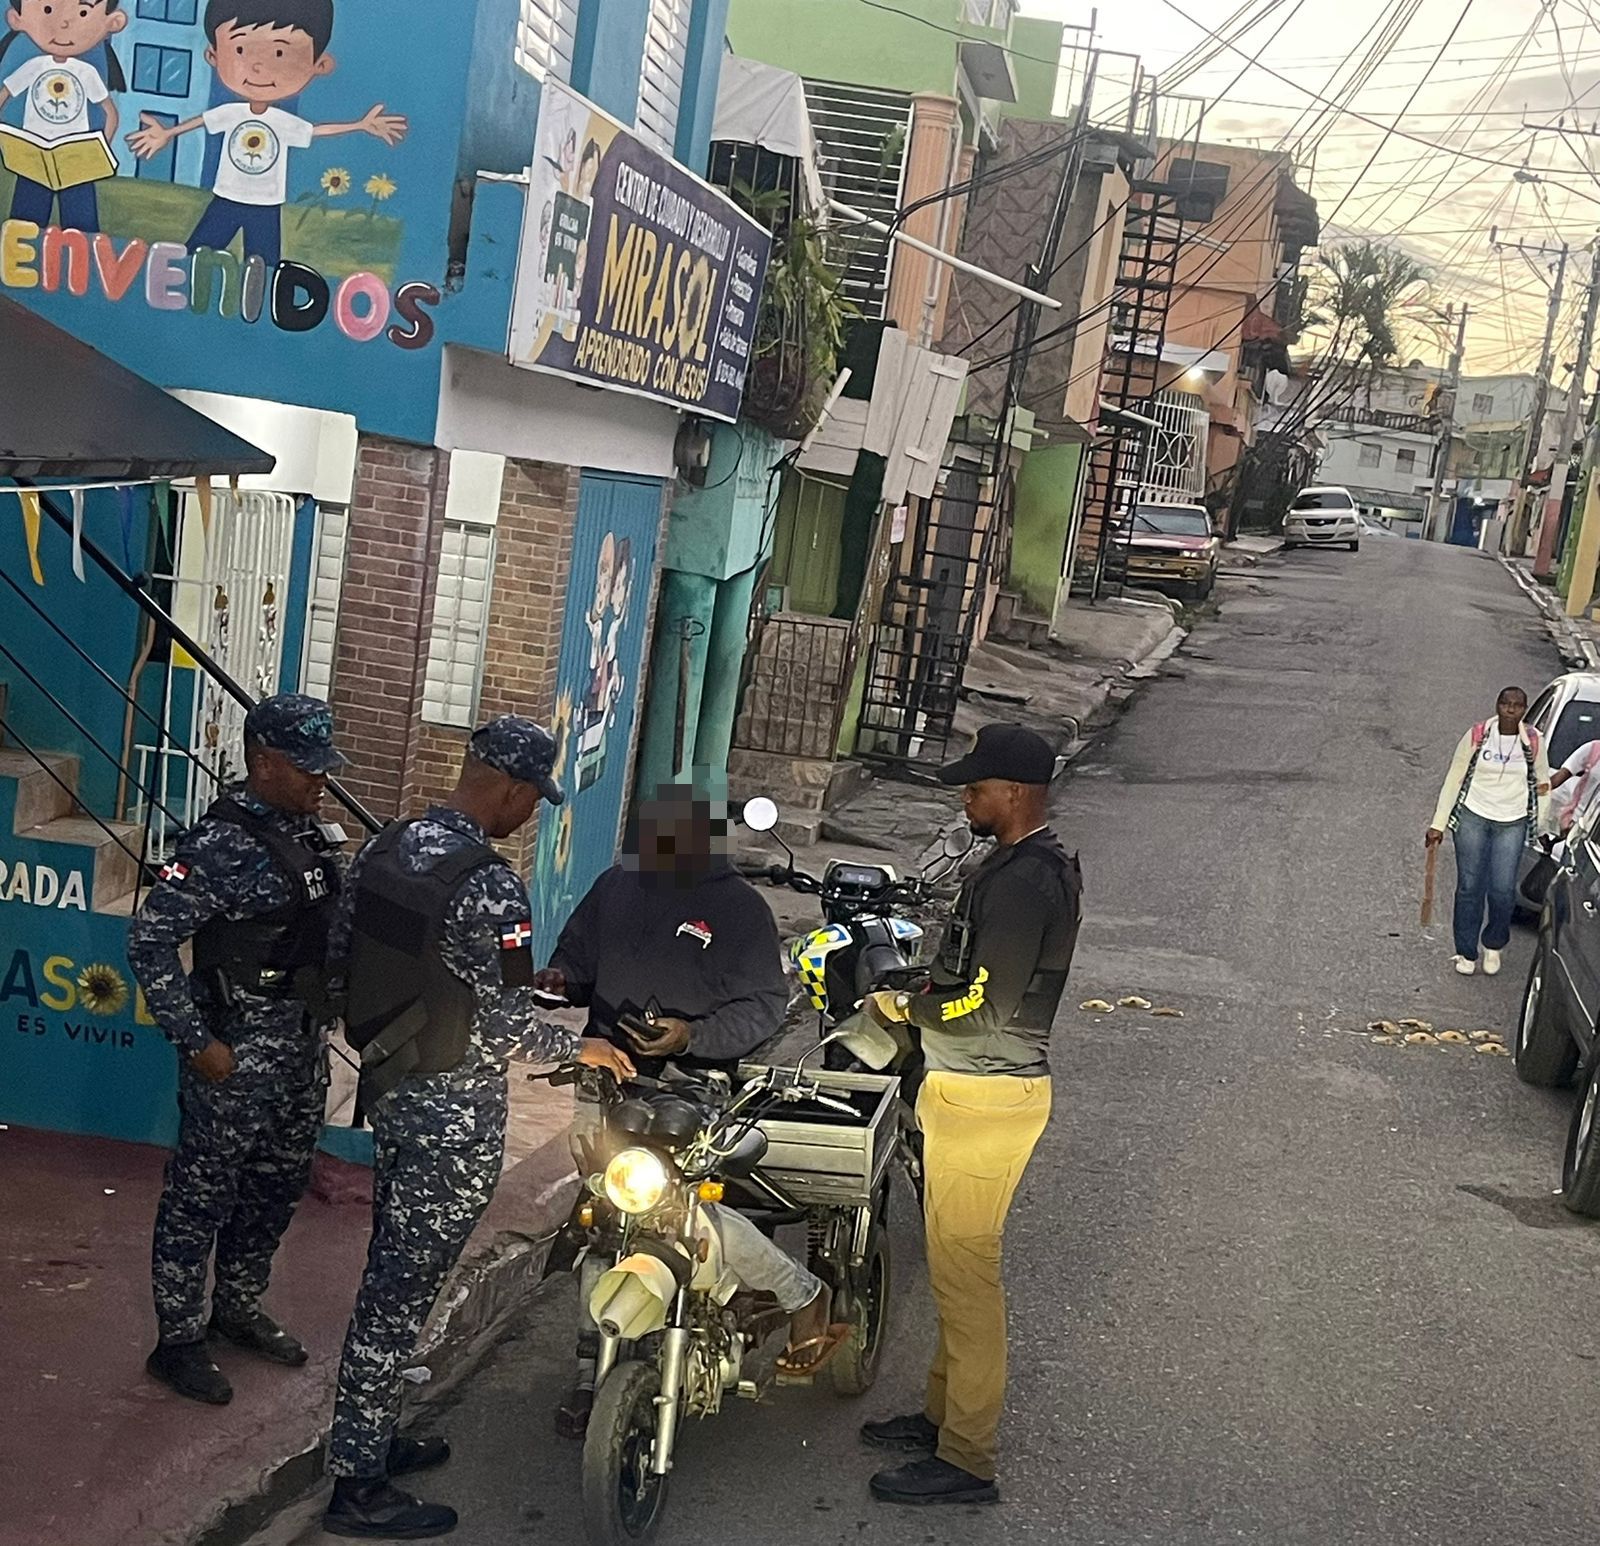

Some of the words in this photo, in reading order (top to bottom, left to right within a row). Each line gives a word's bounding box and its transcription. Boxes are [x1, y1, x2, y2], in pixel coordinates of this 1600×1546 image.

[614, 161, 650, 216] CENTRO
[645, 181, 662, 222] DE
[595, 212, 718, 362] MIRASOL
[573, 325, 652, 387] APRENDIENDO
[652, 352, 680, 393] CON
[675, 362, 708, 402] JESUS
[303, 867, 324, 885] PO
[17, 1013, 47, 1036] ES
[63, 1021, 135, 1049] VIVIR
